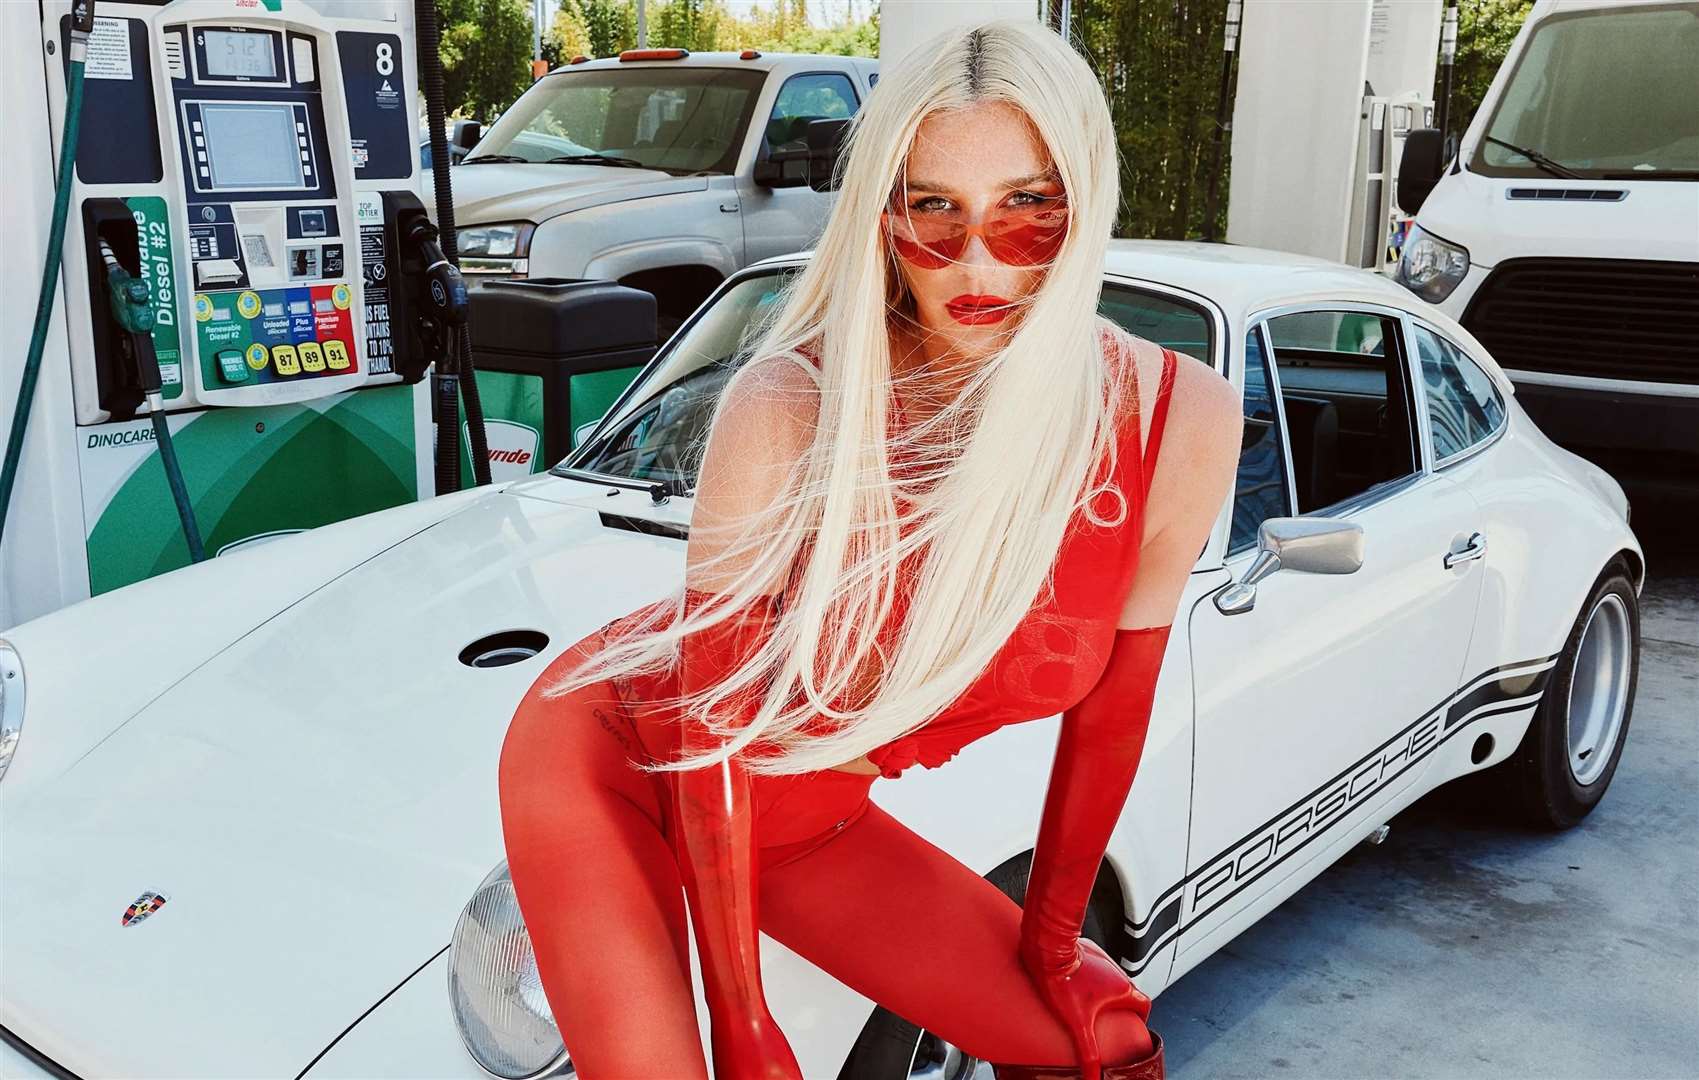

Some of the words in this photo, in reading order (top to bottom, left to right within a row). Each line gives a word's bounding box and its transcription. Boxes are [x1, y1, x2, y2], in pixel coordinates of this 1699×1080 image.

[197, 35, 204, 46] $
[376, 43, 394, 75] 8
[149, 221, 168, 249] #2
[152, 256, 174, 326] Diesel
[374, 304, 390, 320] FUEL
[205, 324, 242, 333] Renewable
[263, 320, 290, 328] Unleaded
[366, 321, 391, 338] NTAINS
[209, 333, 230, 341] Diesel
[329, 349, 344, 361] 91
[368, 341, 378, 356] TO
[379, 338, 393, 355] 10%
[279, 354, 293, 367] 87
[304, 351, 319, 364] 89
[368, 356, 391, 374] THANOL
[87, 428, 157, 449] DINOCARE
[488, 449, 531, 464] yride
[1192, 715, 1440, 913] PORSCHE
